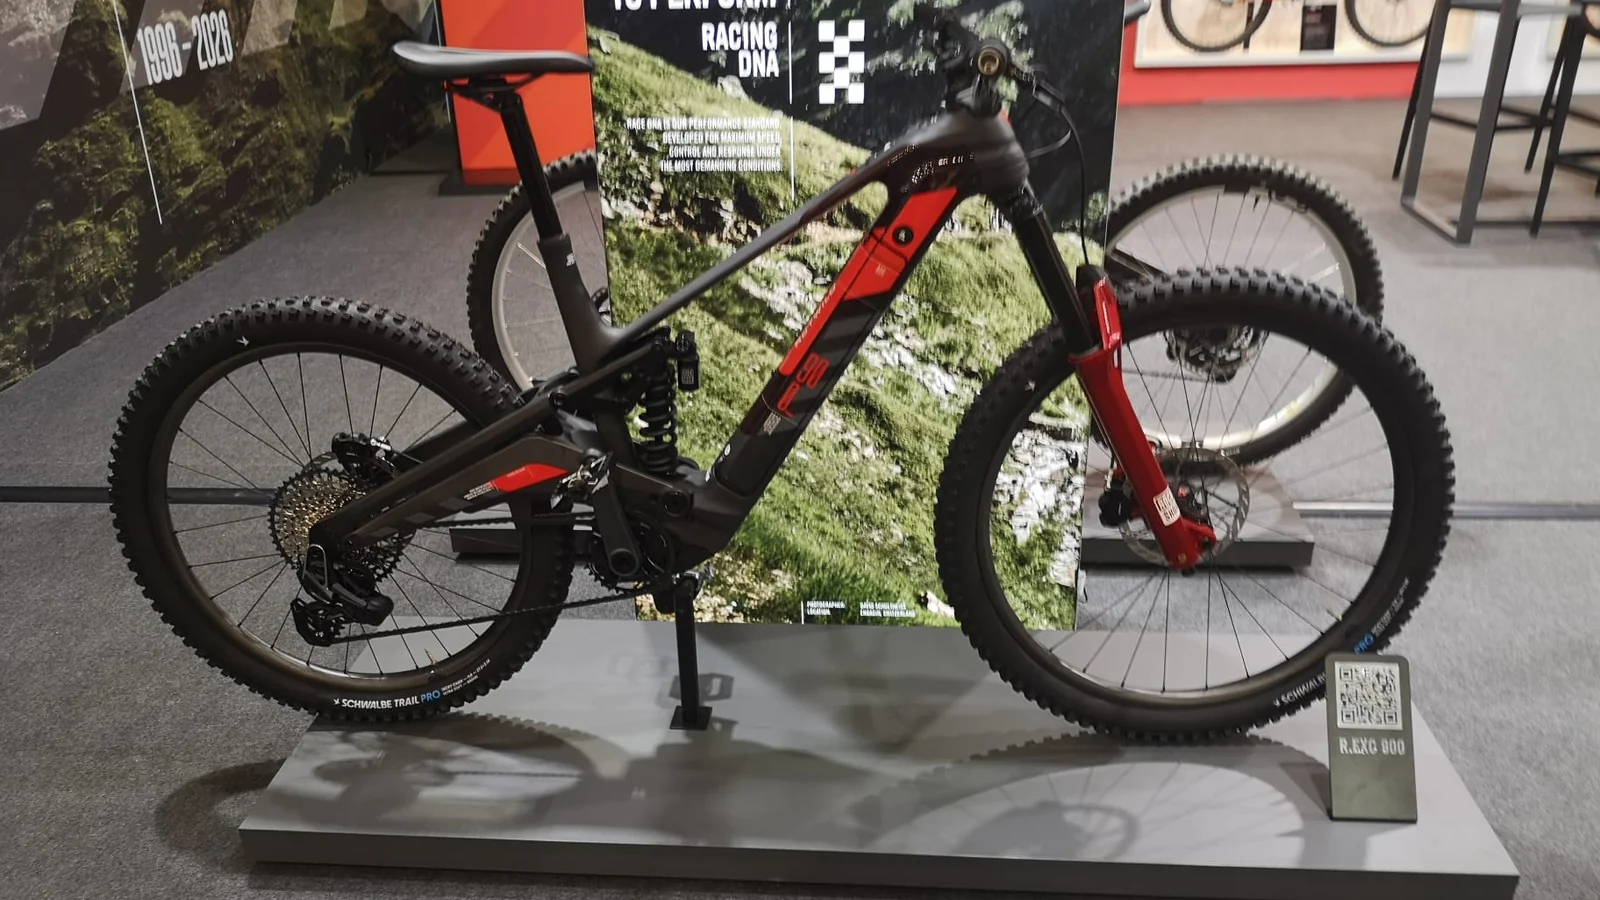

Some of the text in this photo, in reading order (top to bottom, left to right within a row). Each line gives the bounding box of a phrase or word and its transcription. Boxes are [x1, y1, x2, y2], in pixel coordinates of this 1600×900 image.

[701, 21, 778, 51] RACING
[137, 21, 182, 85] 1996
[191, 9, 233, 70] 2026
[738, 50, 779, 78] DNA
[626, 117, 646, 130] RACE
[647, 117, 662, 130] DNA
[663, 117, 671, 130] IS
[671, 117, 687, 130] OUR
[689, 117, 741, 130] PERFORMANCE
[663, 131, 704, 144] DEVELOPED
[705, 131, 719, 144] FOR
[720, 131, 756, 144] MAXIMUM
[668, 145, 781, 158] CONTROL AND RESPONSE UNDER
[660, 159, 673, 172] THE
[674, 159, 694, 172] MOST
[695, 159, 738, 172] DEMANDING
[341, 690, 441, 710] SCHWALBE TRAIL PRO
